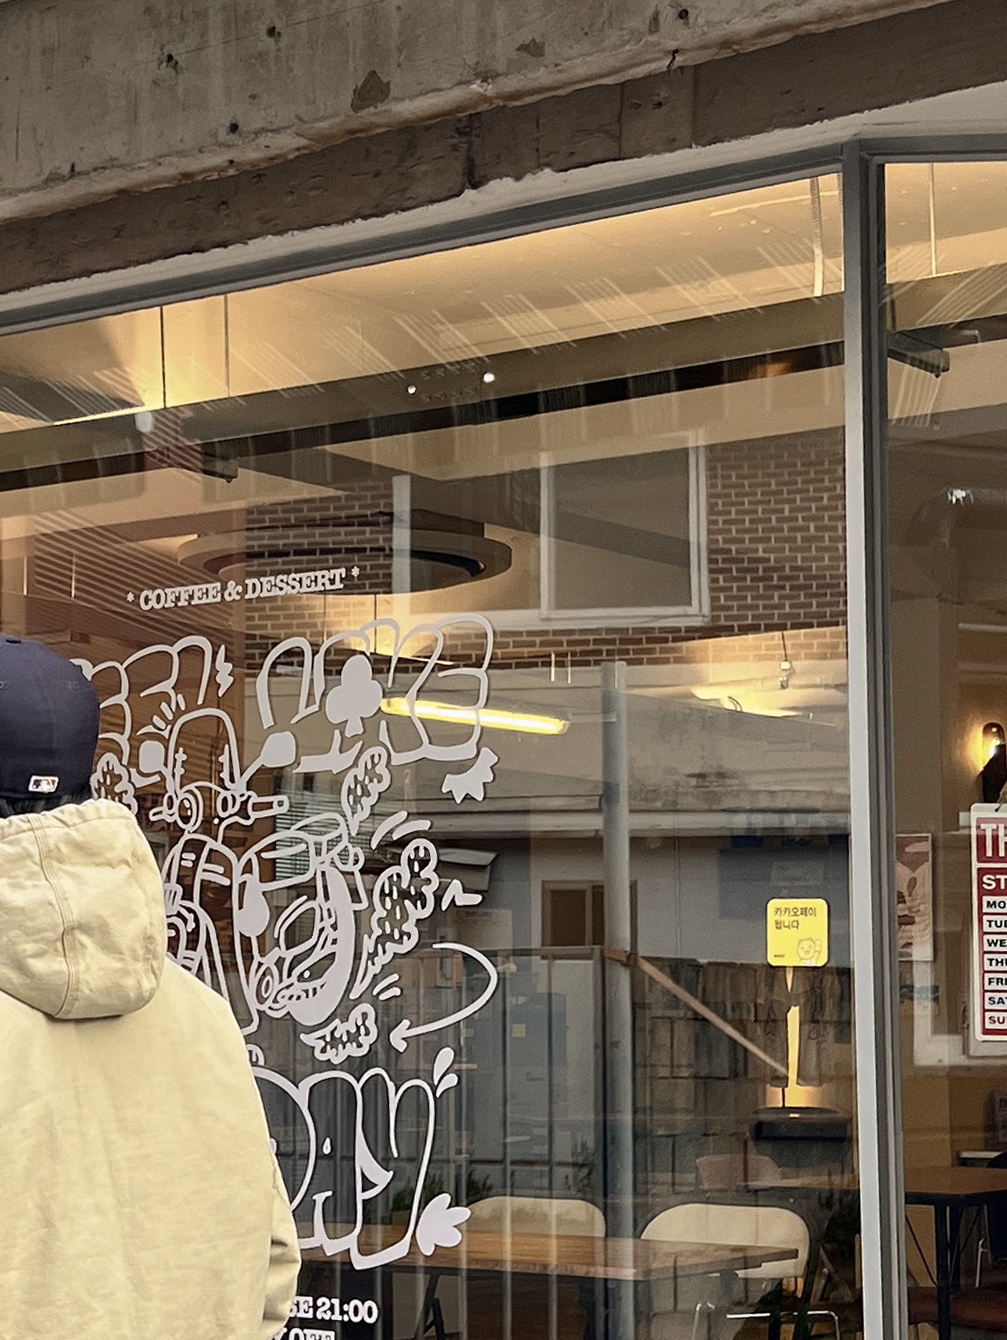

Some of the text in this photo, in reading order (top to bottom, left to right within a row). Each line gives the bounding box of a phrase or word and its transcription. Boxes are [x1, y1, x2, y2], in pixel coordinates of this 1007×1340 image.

[139, 567, 346, 611] COFFEE & DESSERT
[986, 900, 1007, 909] MO
[774, 906, 817, 917] 카카오페이
[774, 919, 800, 930] 됩니다
[316, 1296, 378, 1323] 21:00
